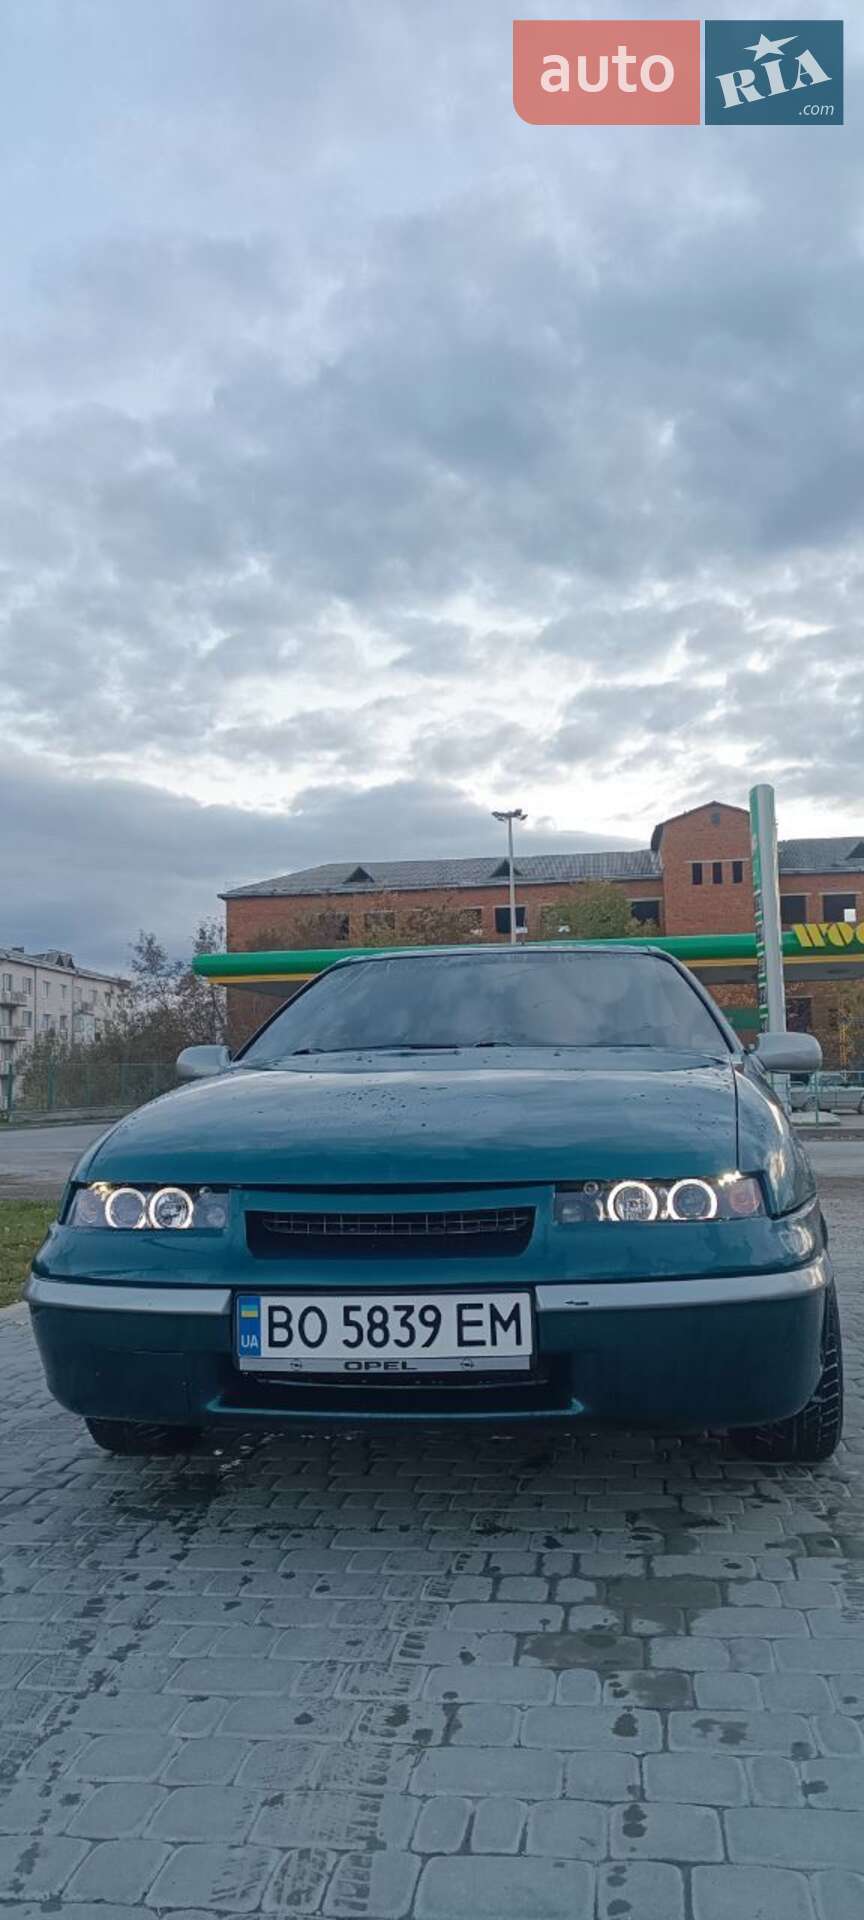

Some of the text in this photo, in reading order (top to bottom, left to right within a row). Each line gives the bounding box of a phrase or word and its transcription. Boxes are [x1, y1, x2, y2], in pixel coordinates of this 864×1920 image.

[267, 1302, 522, 1348] BO 5839 EM
[240, 1334, 258, 1348] UA
[343, 1361, 418, 1371] OPEL
